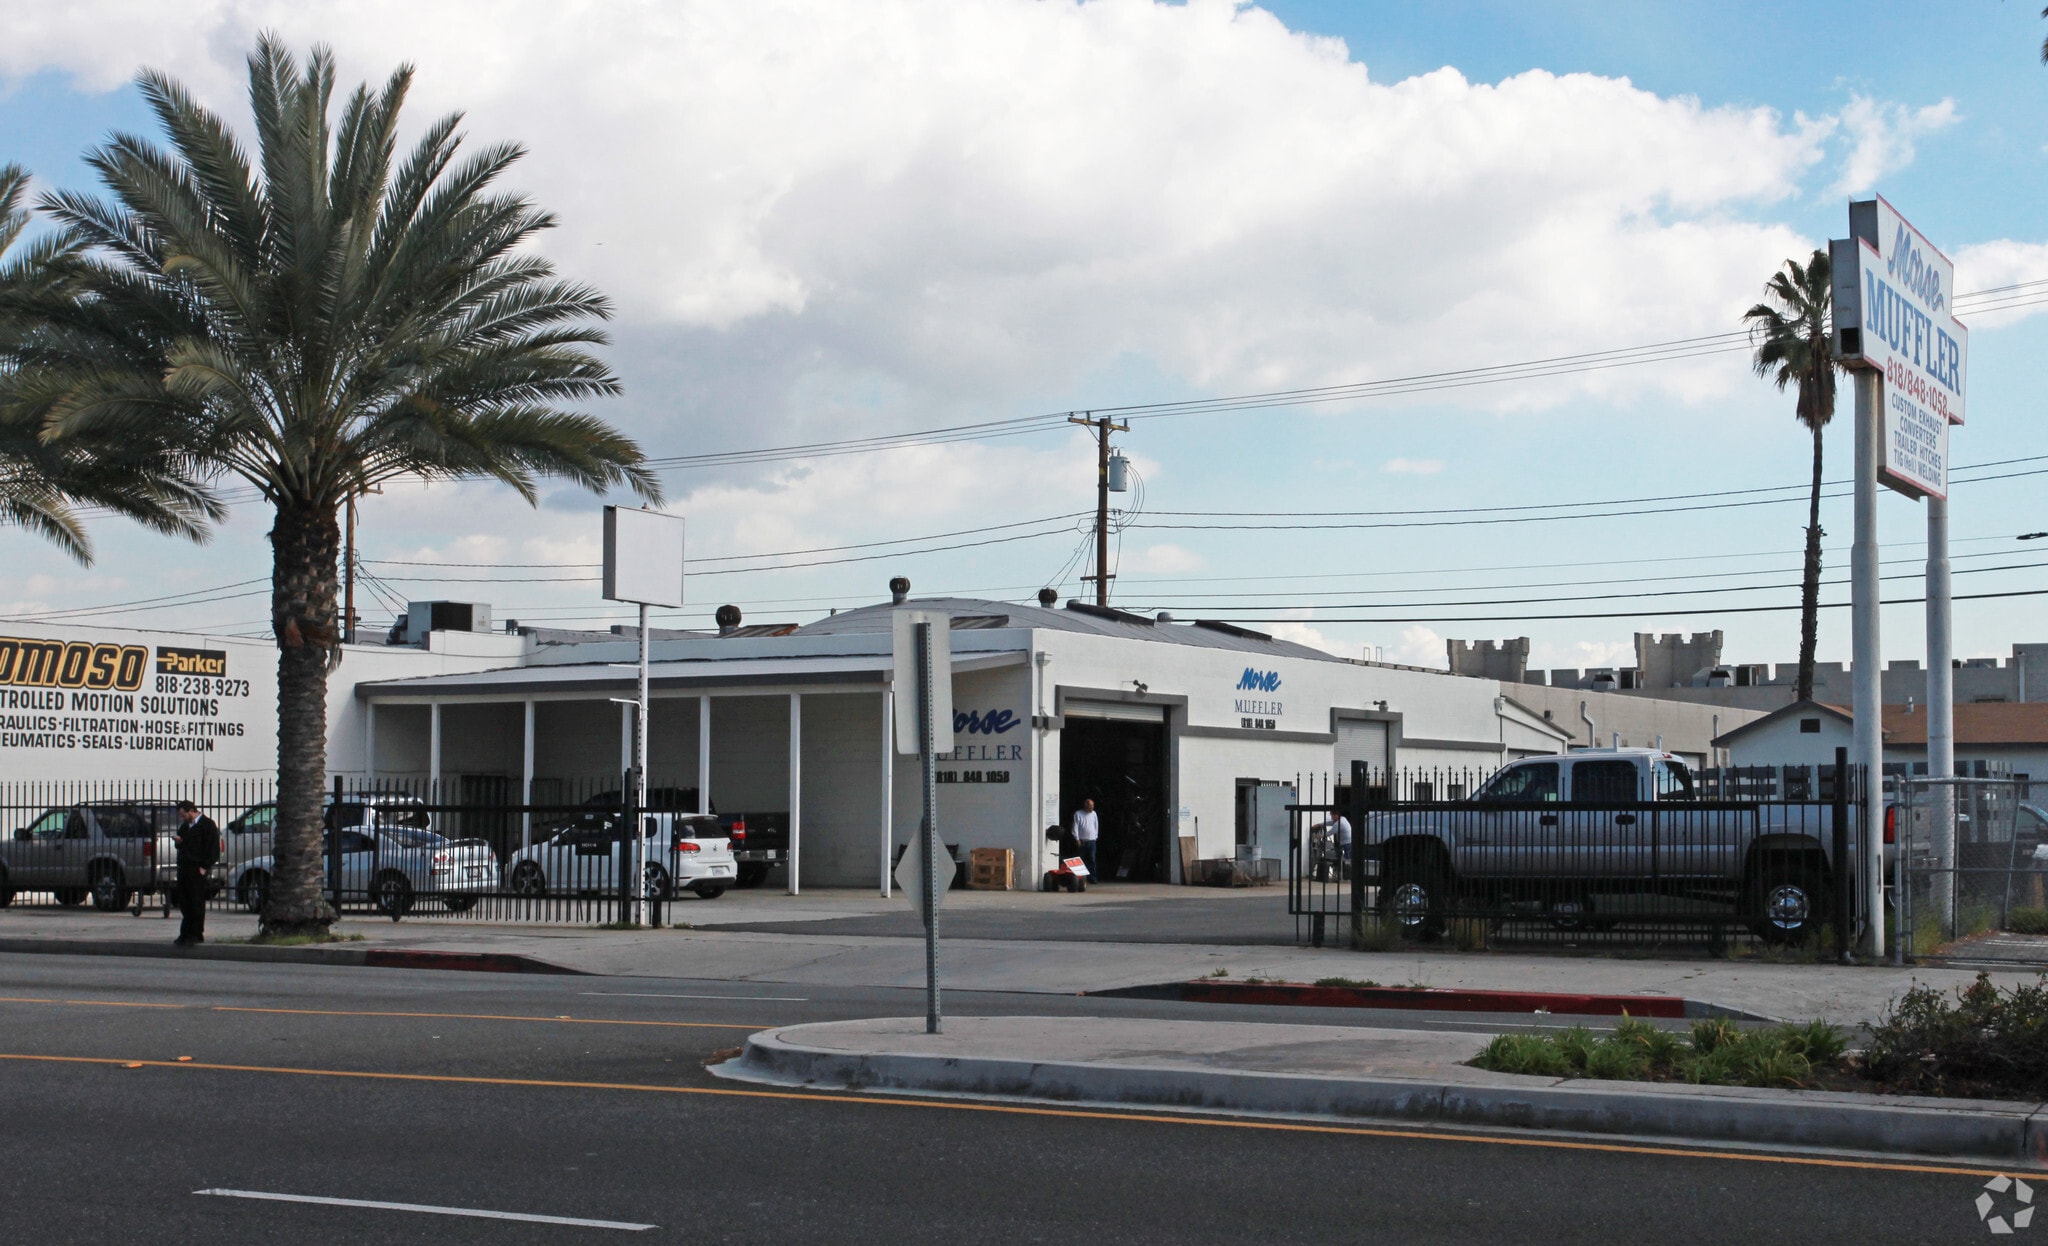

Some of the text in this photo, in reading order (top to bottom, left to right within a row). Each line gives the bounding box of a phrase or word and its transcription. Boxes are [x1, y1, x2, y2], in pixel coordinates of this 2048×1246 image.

[1888, 221, 1945, 312] Morse
[1866, 267, 1961, 397] MUFFLER
[1892, 392, 1942, 436] CUSTOM EXHAUST
[1900, 415, 1937, 450] CONVERTERS
[1894, 430, 1942, 471] TRAILER HITCHES
[1918, 460, 1942, 487] WELDING
[166, 651, 225, 674] Parker
[1236, 667, 1282, 692] Morse
[0, 689, 219, 716] TROLLED MOTION SOLUTIONS
[1234, 699, 1283, 716] MUFFLER
[952, 708, 1021, 735] orse
[0, 732, 76, 749] EUMATICS
[916, 744, 1023, 761] UFFLER
[963, 770, 982, 784] 848
[985, 770, 1010, 784] 1058
